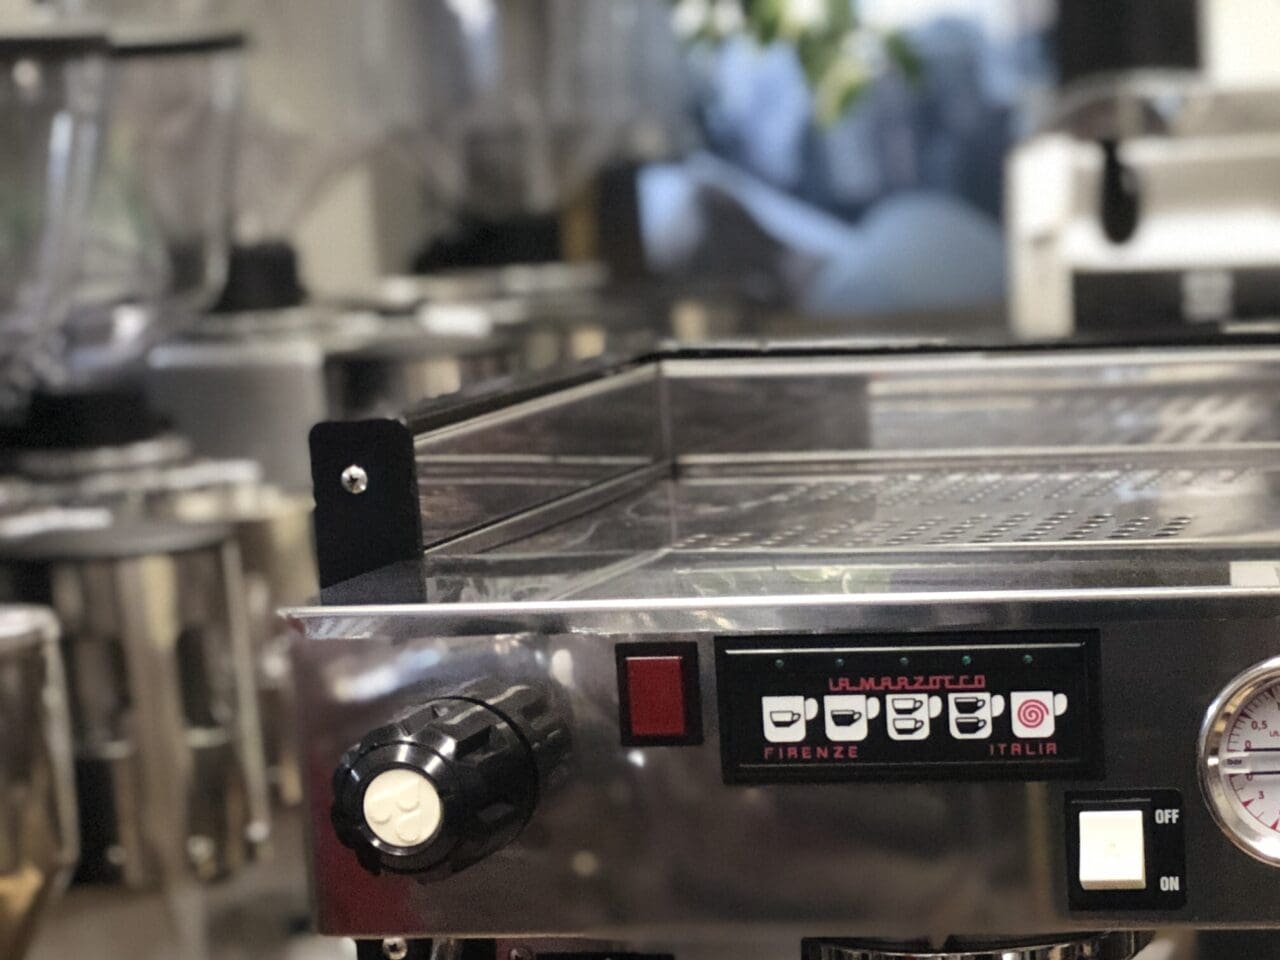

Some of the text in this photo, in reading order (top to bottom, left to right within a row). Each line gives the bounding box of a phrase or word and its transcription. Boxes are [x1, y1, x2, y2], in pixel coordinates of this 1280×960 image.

[763, 742, 1058, 760] FIRENZE ITALIA
[1155, 808, 1180, 824] OFF
[1160, 876, 1180, 891] ON
